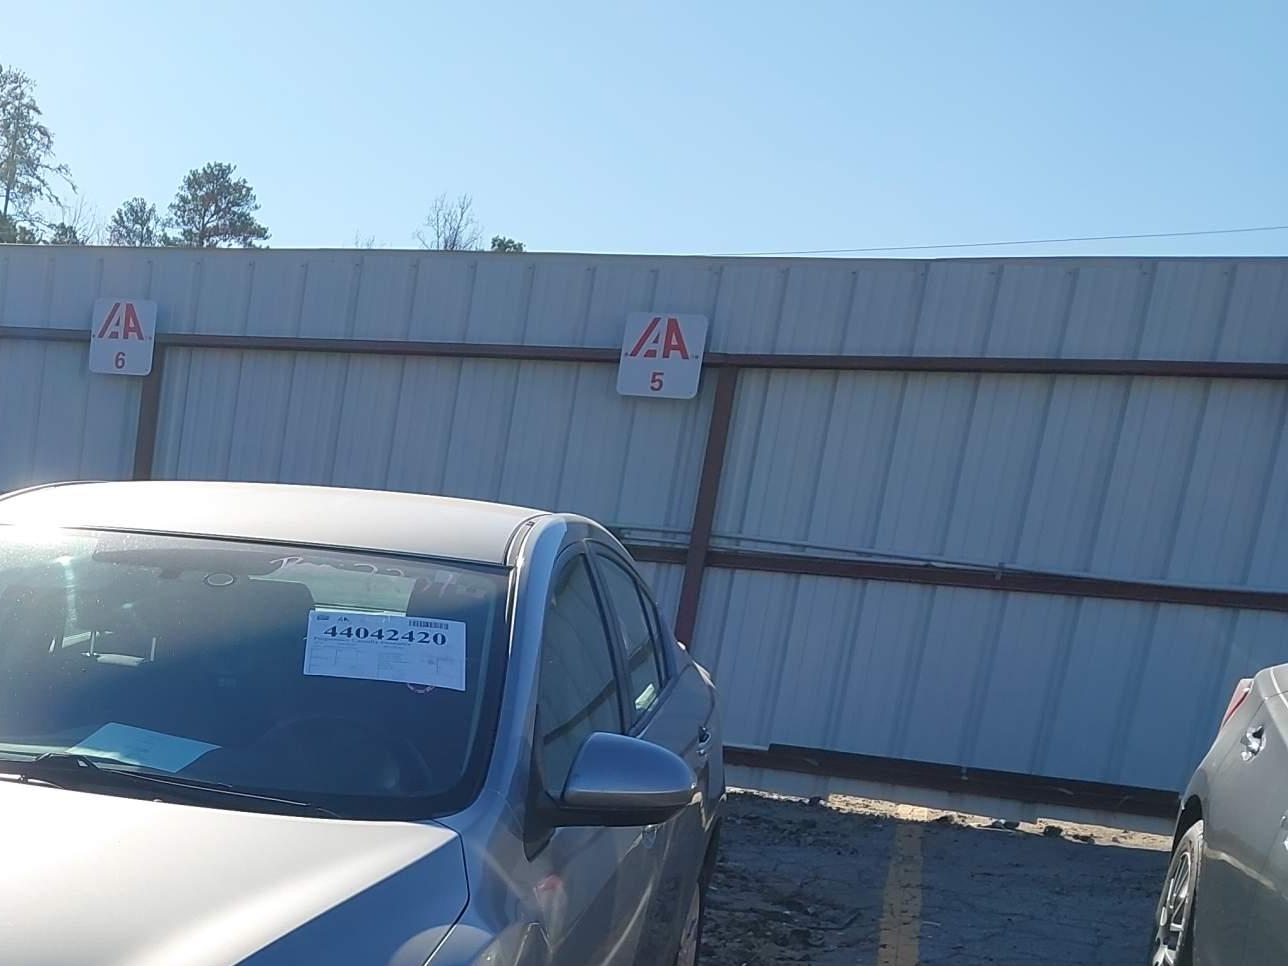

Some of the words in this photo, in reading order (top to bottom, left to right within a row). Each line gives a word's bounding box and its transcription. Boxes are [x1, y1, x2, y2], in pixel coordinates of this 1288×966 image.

[114, 351, 126, 369] 6
[650, 372, 665, 392] 5
[323, 625, 447, 646] 44042420
